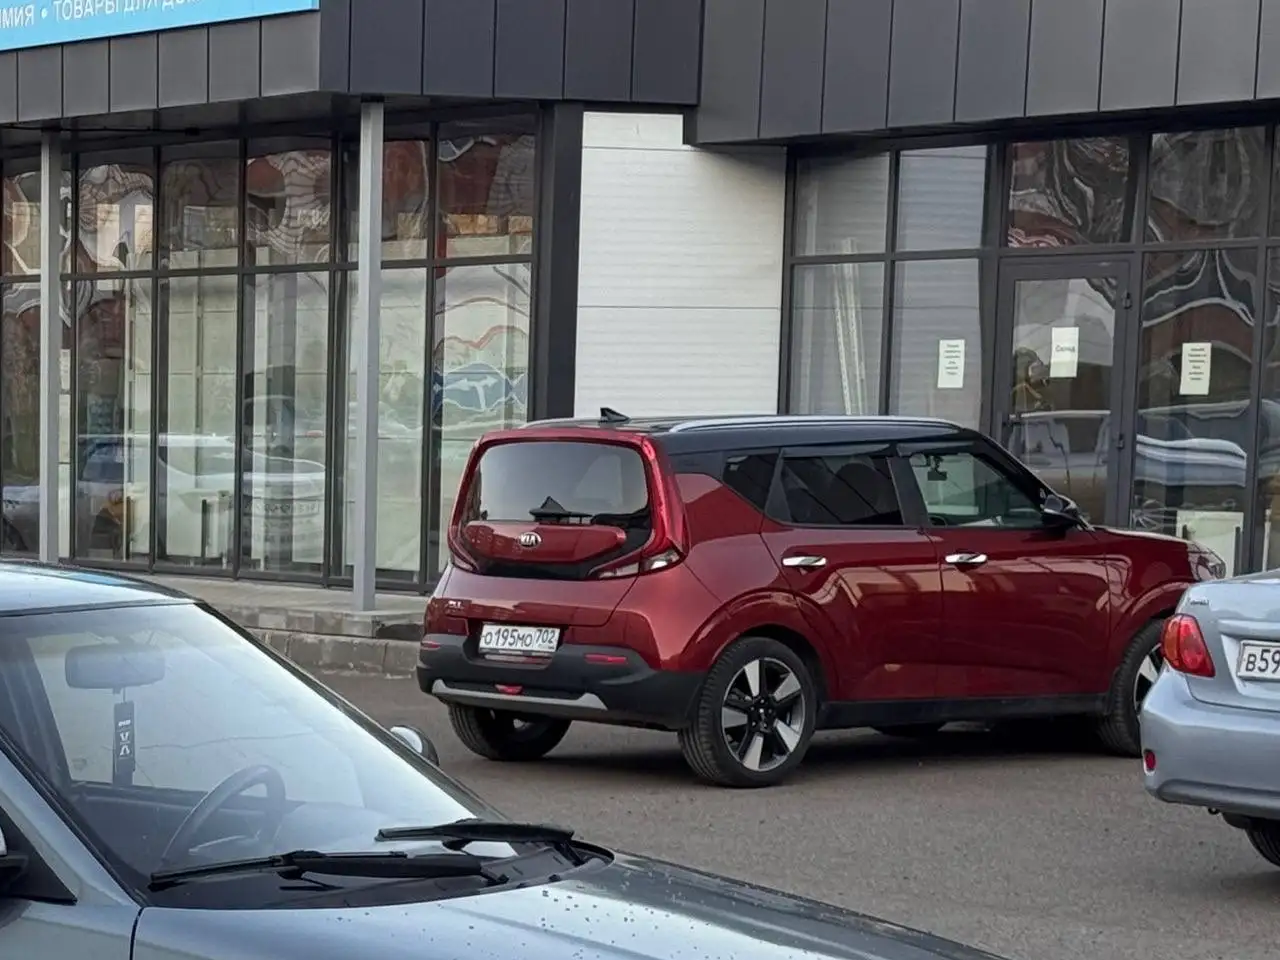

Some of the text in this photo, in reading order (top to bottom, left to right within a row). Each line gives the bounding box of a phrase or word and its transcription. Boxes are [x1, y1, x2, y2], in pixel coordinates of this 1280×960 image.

[53, 0, 119, 22] ТОВАРЫ
[520, 534, 537, 546] KIA
[536, 628, 556, 644] 702
